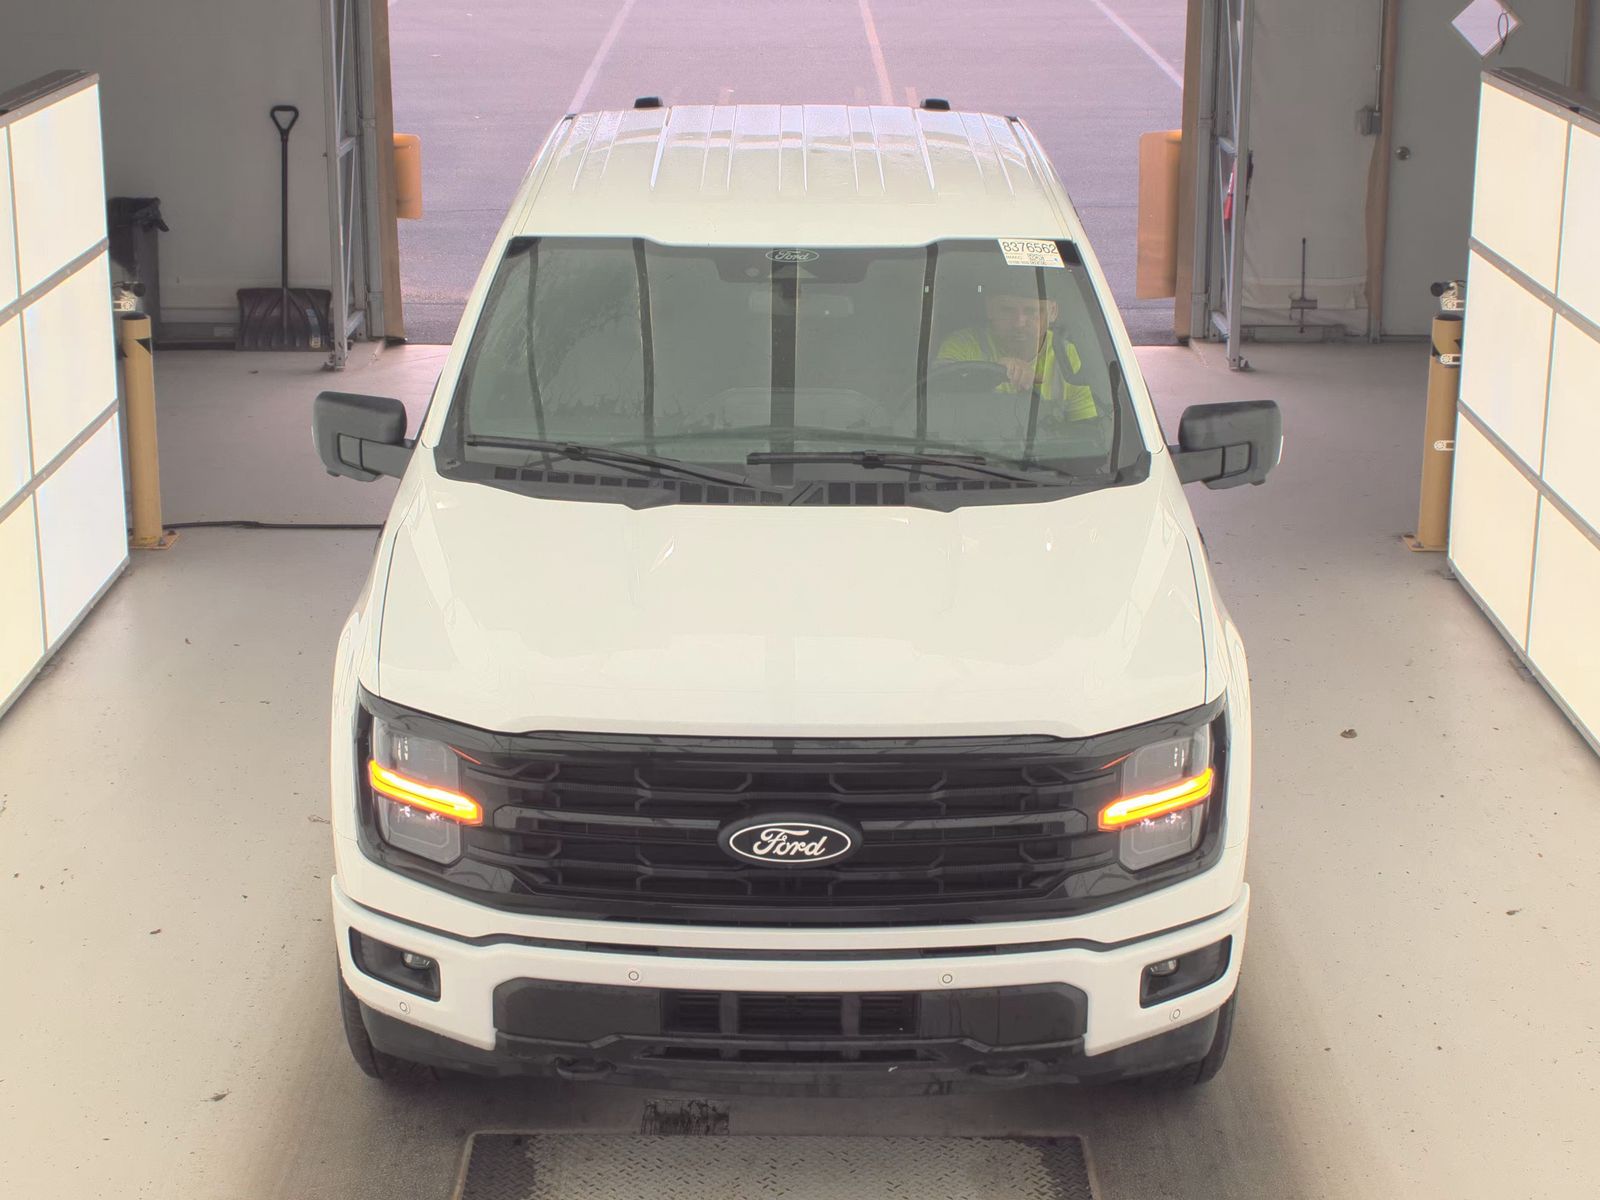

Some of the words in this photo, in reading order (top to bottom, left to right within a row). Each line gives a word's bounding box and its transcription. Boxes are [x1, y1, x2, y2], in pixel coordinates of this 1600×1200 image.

[1002, 241, 1058, 254] 8376562
[775, 250, 809, 260] Ford
[752, 828, 828, 856] Ford
